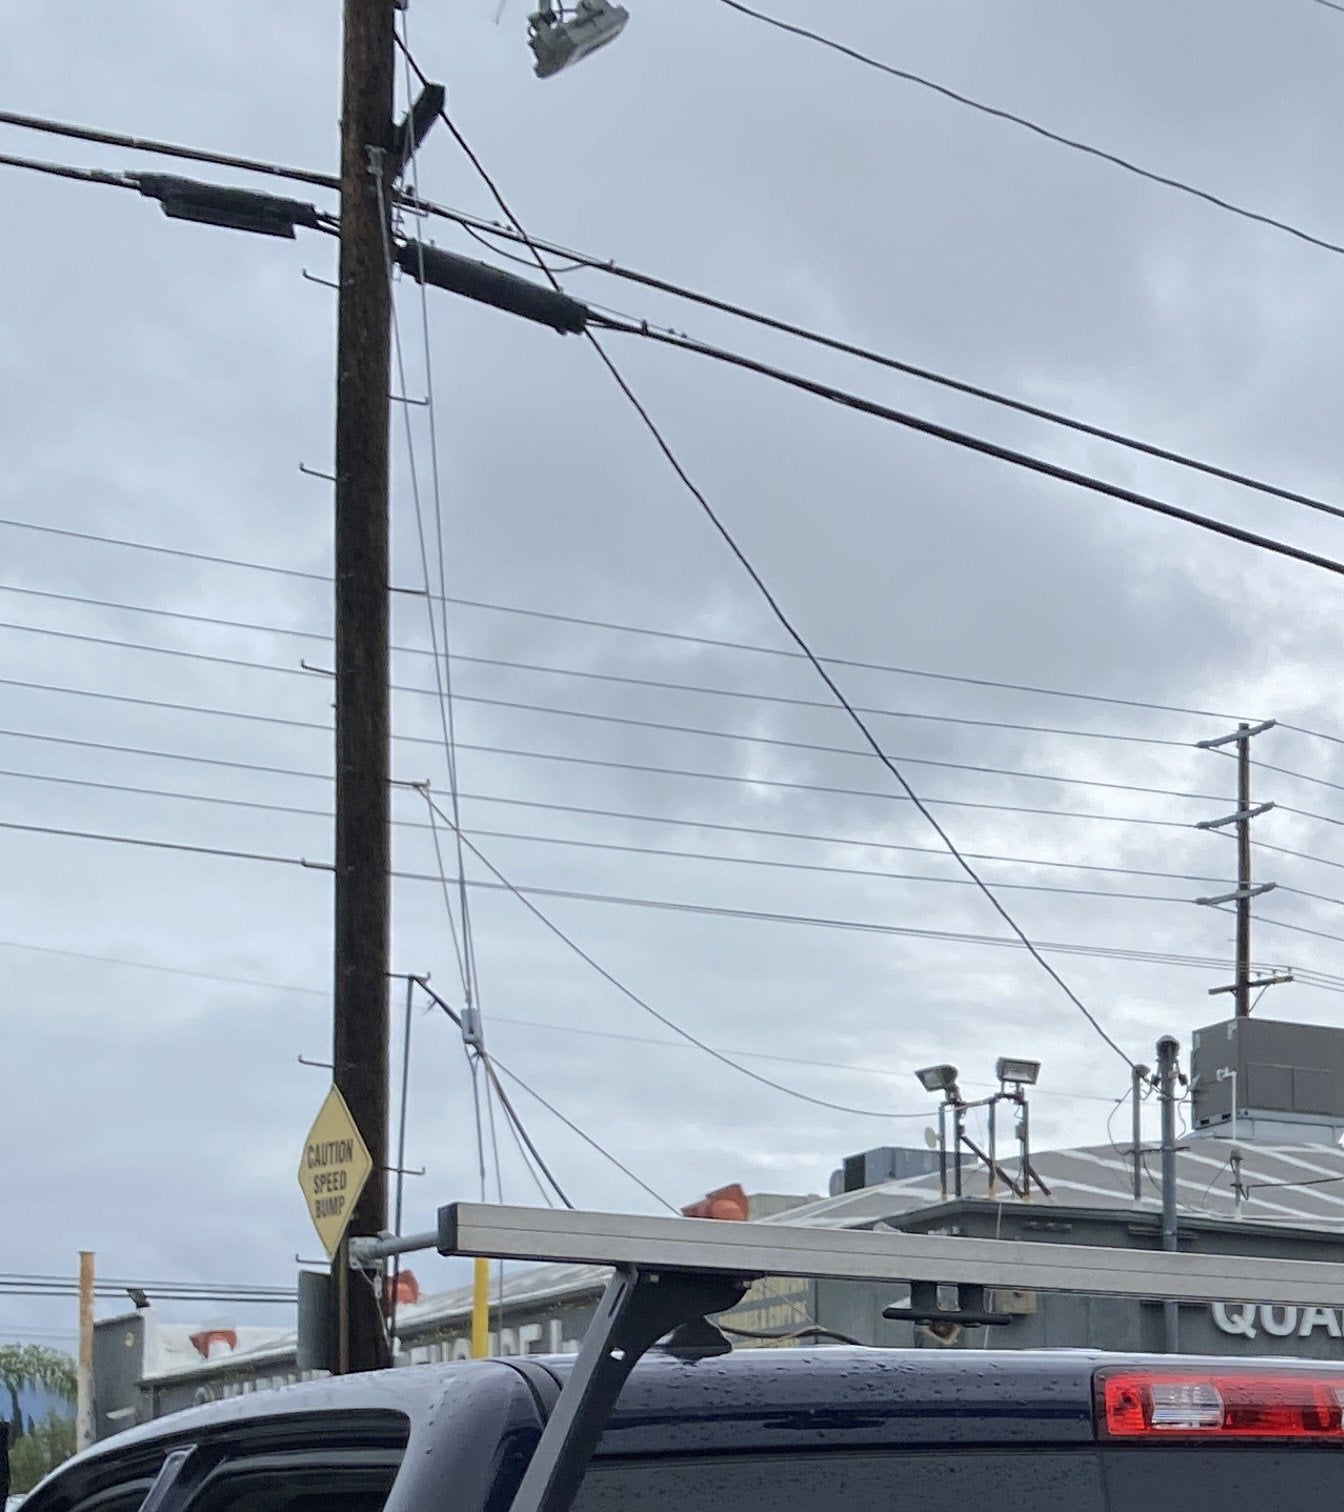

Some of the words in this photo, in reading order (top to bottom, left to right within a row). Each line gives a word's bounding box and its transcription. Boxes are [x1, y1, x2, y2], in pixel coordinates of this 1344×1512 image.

[307, 1139, 353, 1168] CAUTION
[314, 1170, 346, 1194] SPEED
[316, 1196, 345, 1218] BUMP
